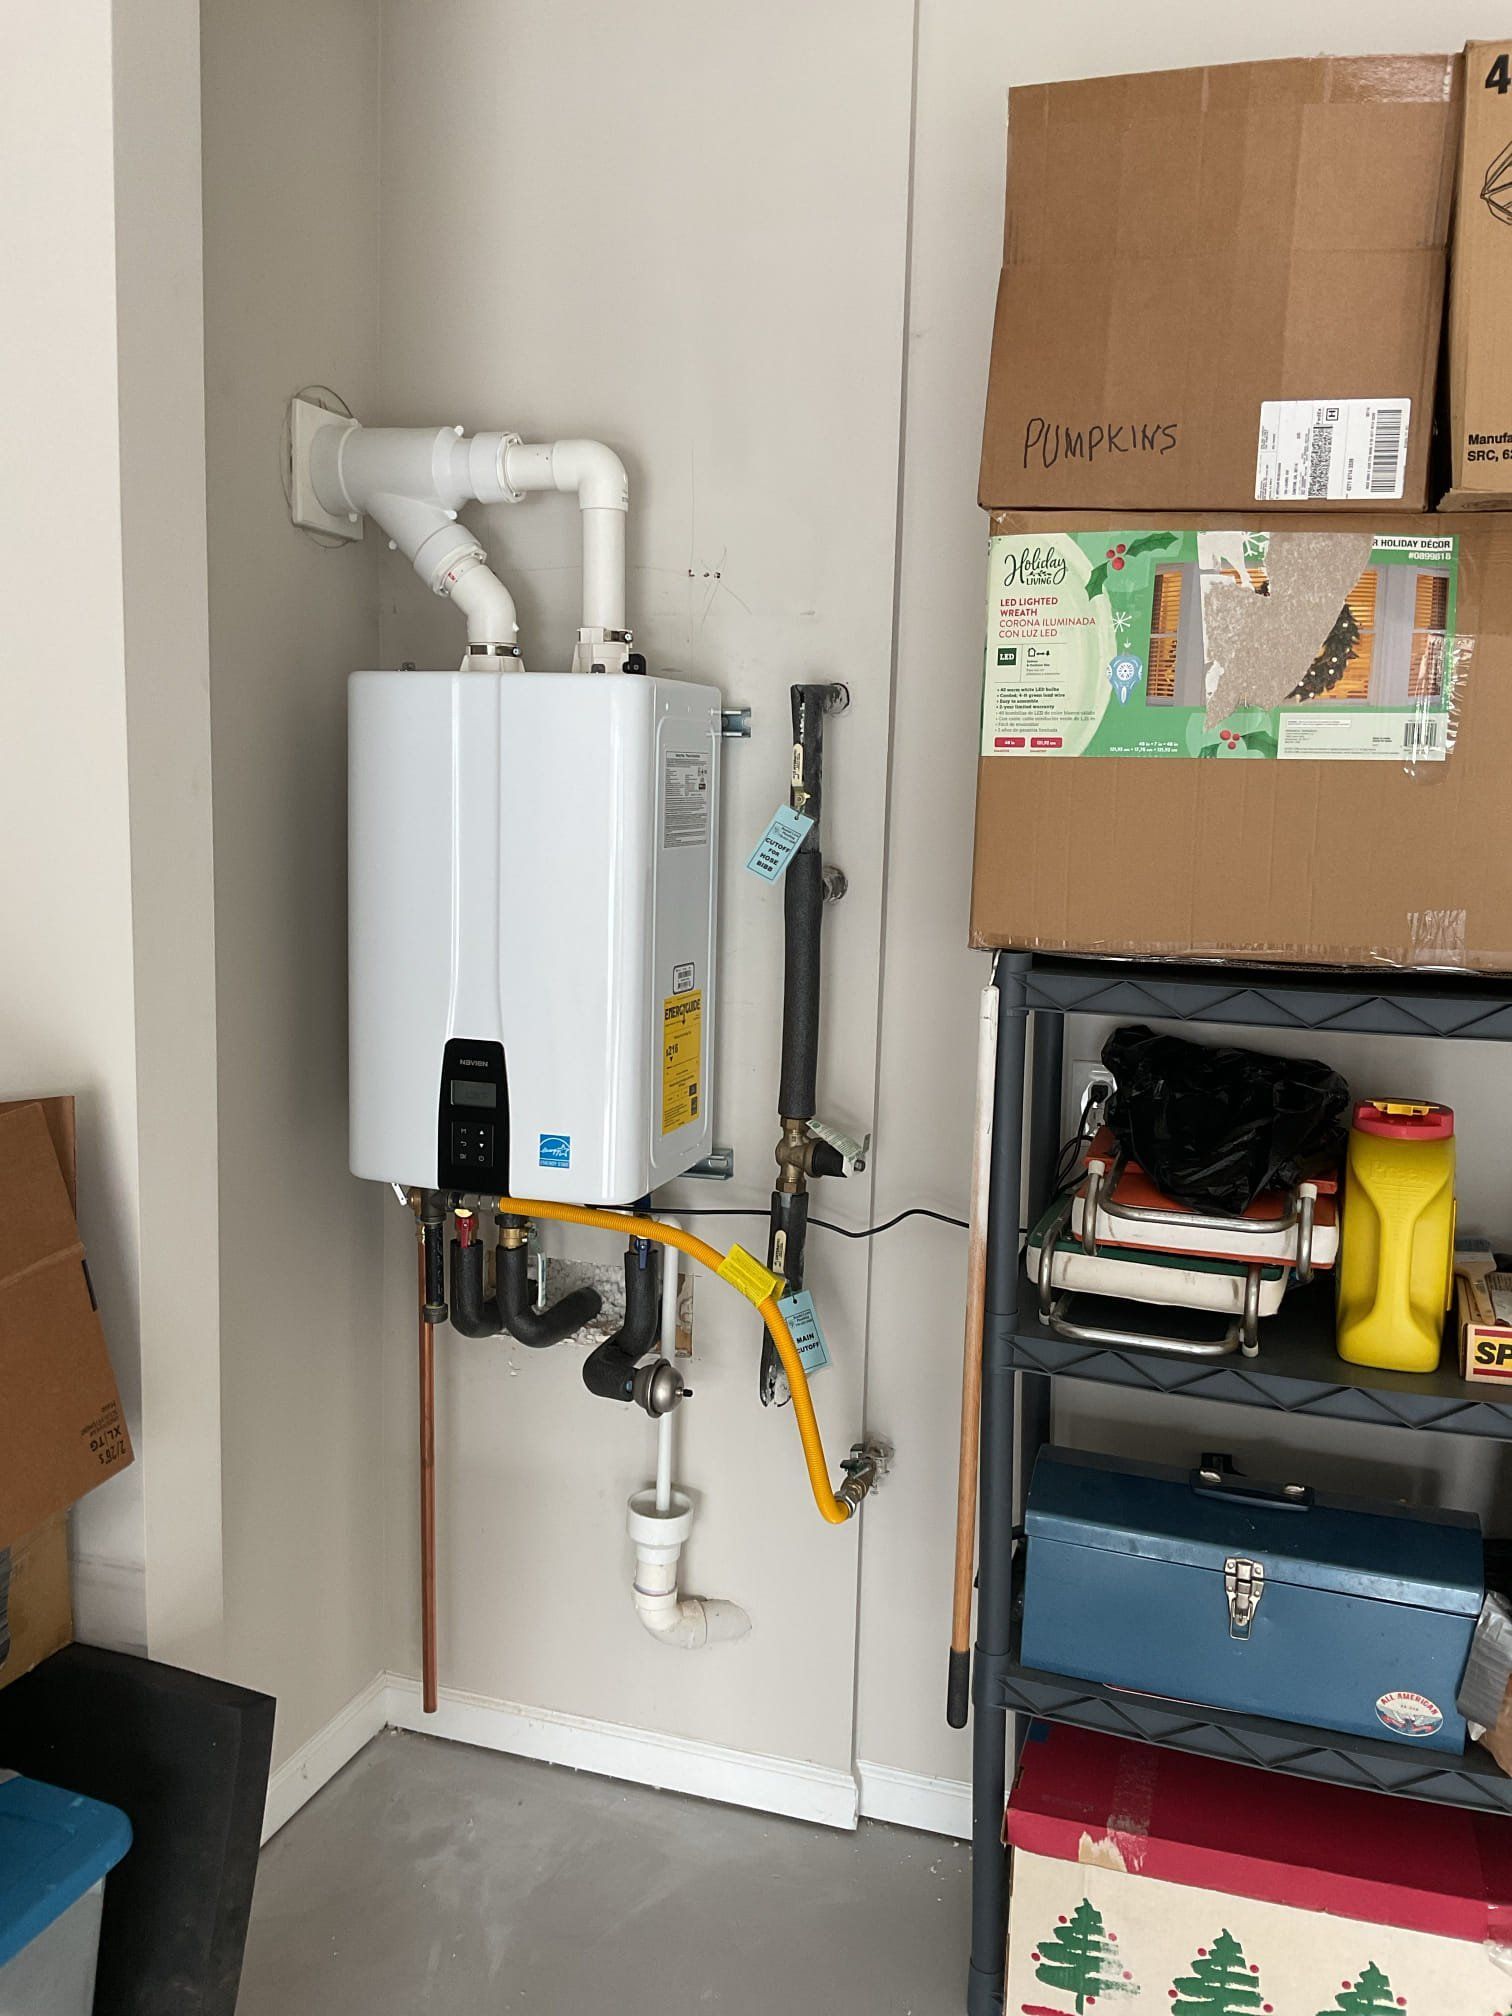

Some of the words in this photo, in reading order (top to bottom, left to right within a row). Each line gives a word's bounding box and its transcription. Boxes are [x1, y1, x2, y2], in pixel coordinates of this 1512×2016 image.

[1485, 54, 1512, 95] 4
[1024, 417, 1178, 469] PUMPKINS
[1467, 449, 1499, 463] SRC,
[1381, 539, 1418, 548] HOLIDAY
[1420, 539, 1450, 549] DÉCOR
[1003, 546, 1066, 587] Holiday
[1026, 577, 1052, 586] LIVING
[1000, 599, 1017, 607] LED
[1019, 597, 1058, 606] LIGHTED
[1000, 608, 1038, 617] WREATH
[999, 618, 1040, 628] CORONA
[1042, 617, 1096, 627] ILUMINADA
[998, 630, 1020, 639] CON
[1022, 629, 1038, 638] LUZ
[1040, 629, 1058, 637] LED
[999, 653, 1015, 661] LED
[765, 837, 791, 853] CUTOFF
[768, 848, 780, 857] FOR
[760, 852, 779, 866] HOSE
[756, 860, 773, 872] BIBB
[796, 1332, 815, 1344] MAIN
[1381, 1694, 1395, 1706] ALL
[1397, 1692, 1439, 1716] AMERICAN
